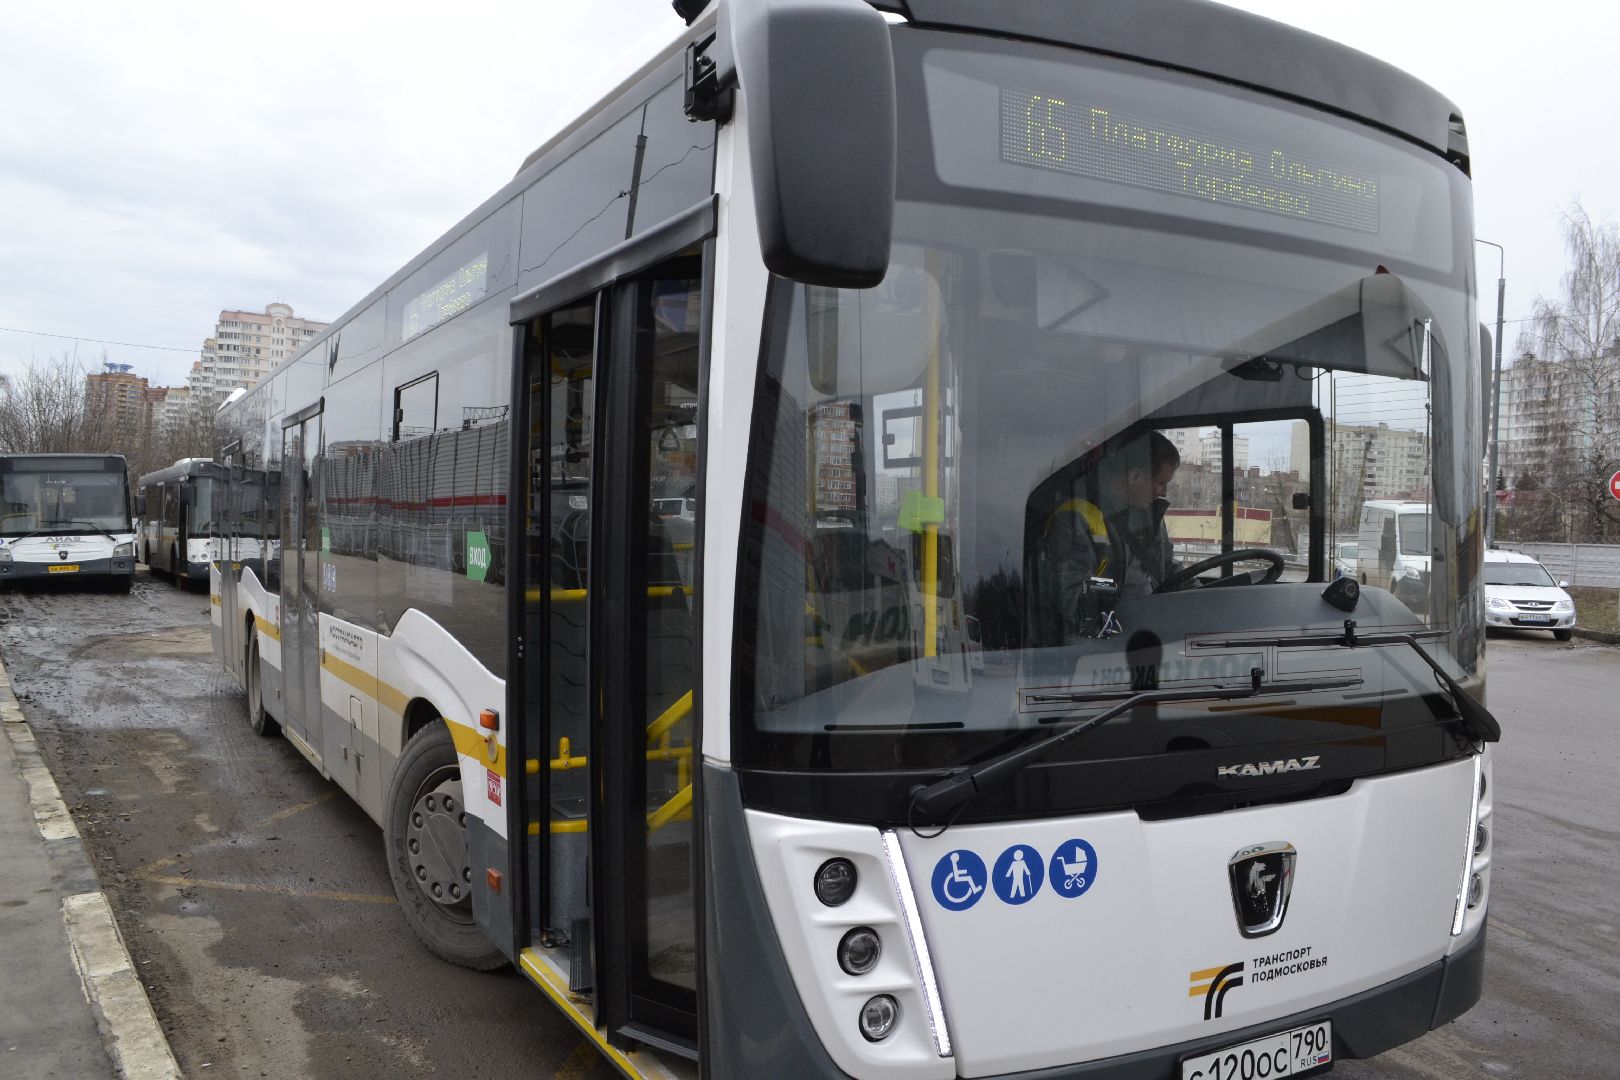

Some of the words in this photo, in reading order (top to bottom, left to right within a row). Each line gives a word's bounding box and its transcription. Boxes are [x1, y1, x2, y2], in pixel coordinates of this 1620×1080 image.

[1027, 95, 1066, 162] 65
[1090, 108, 1252, 173] Платформа
[1270, 150, 1376, 199] Ольгино
[1176, 162, 1309, 215] Торбеево
[470, 546, 486, 569] ВХОД
[1217, 755, 1321, 777] KAMAZ
[1251, 956, 1328, 984] ПОДМОСКОВЬЯ
[1252, 946, 1312, 969] ТРАНСПОРТ
[1292, 1026, 1326, 1060] 790
[1300, 1057, 1318, 1069] RUS
